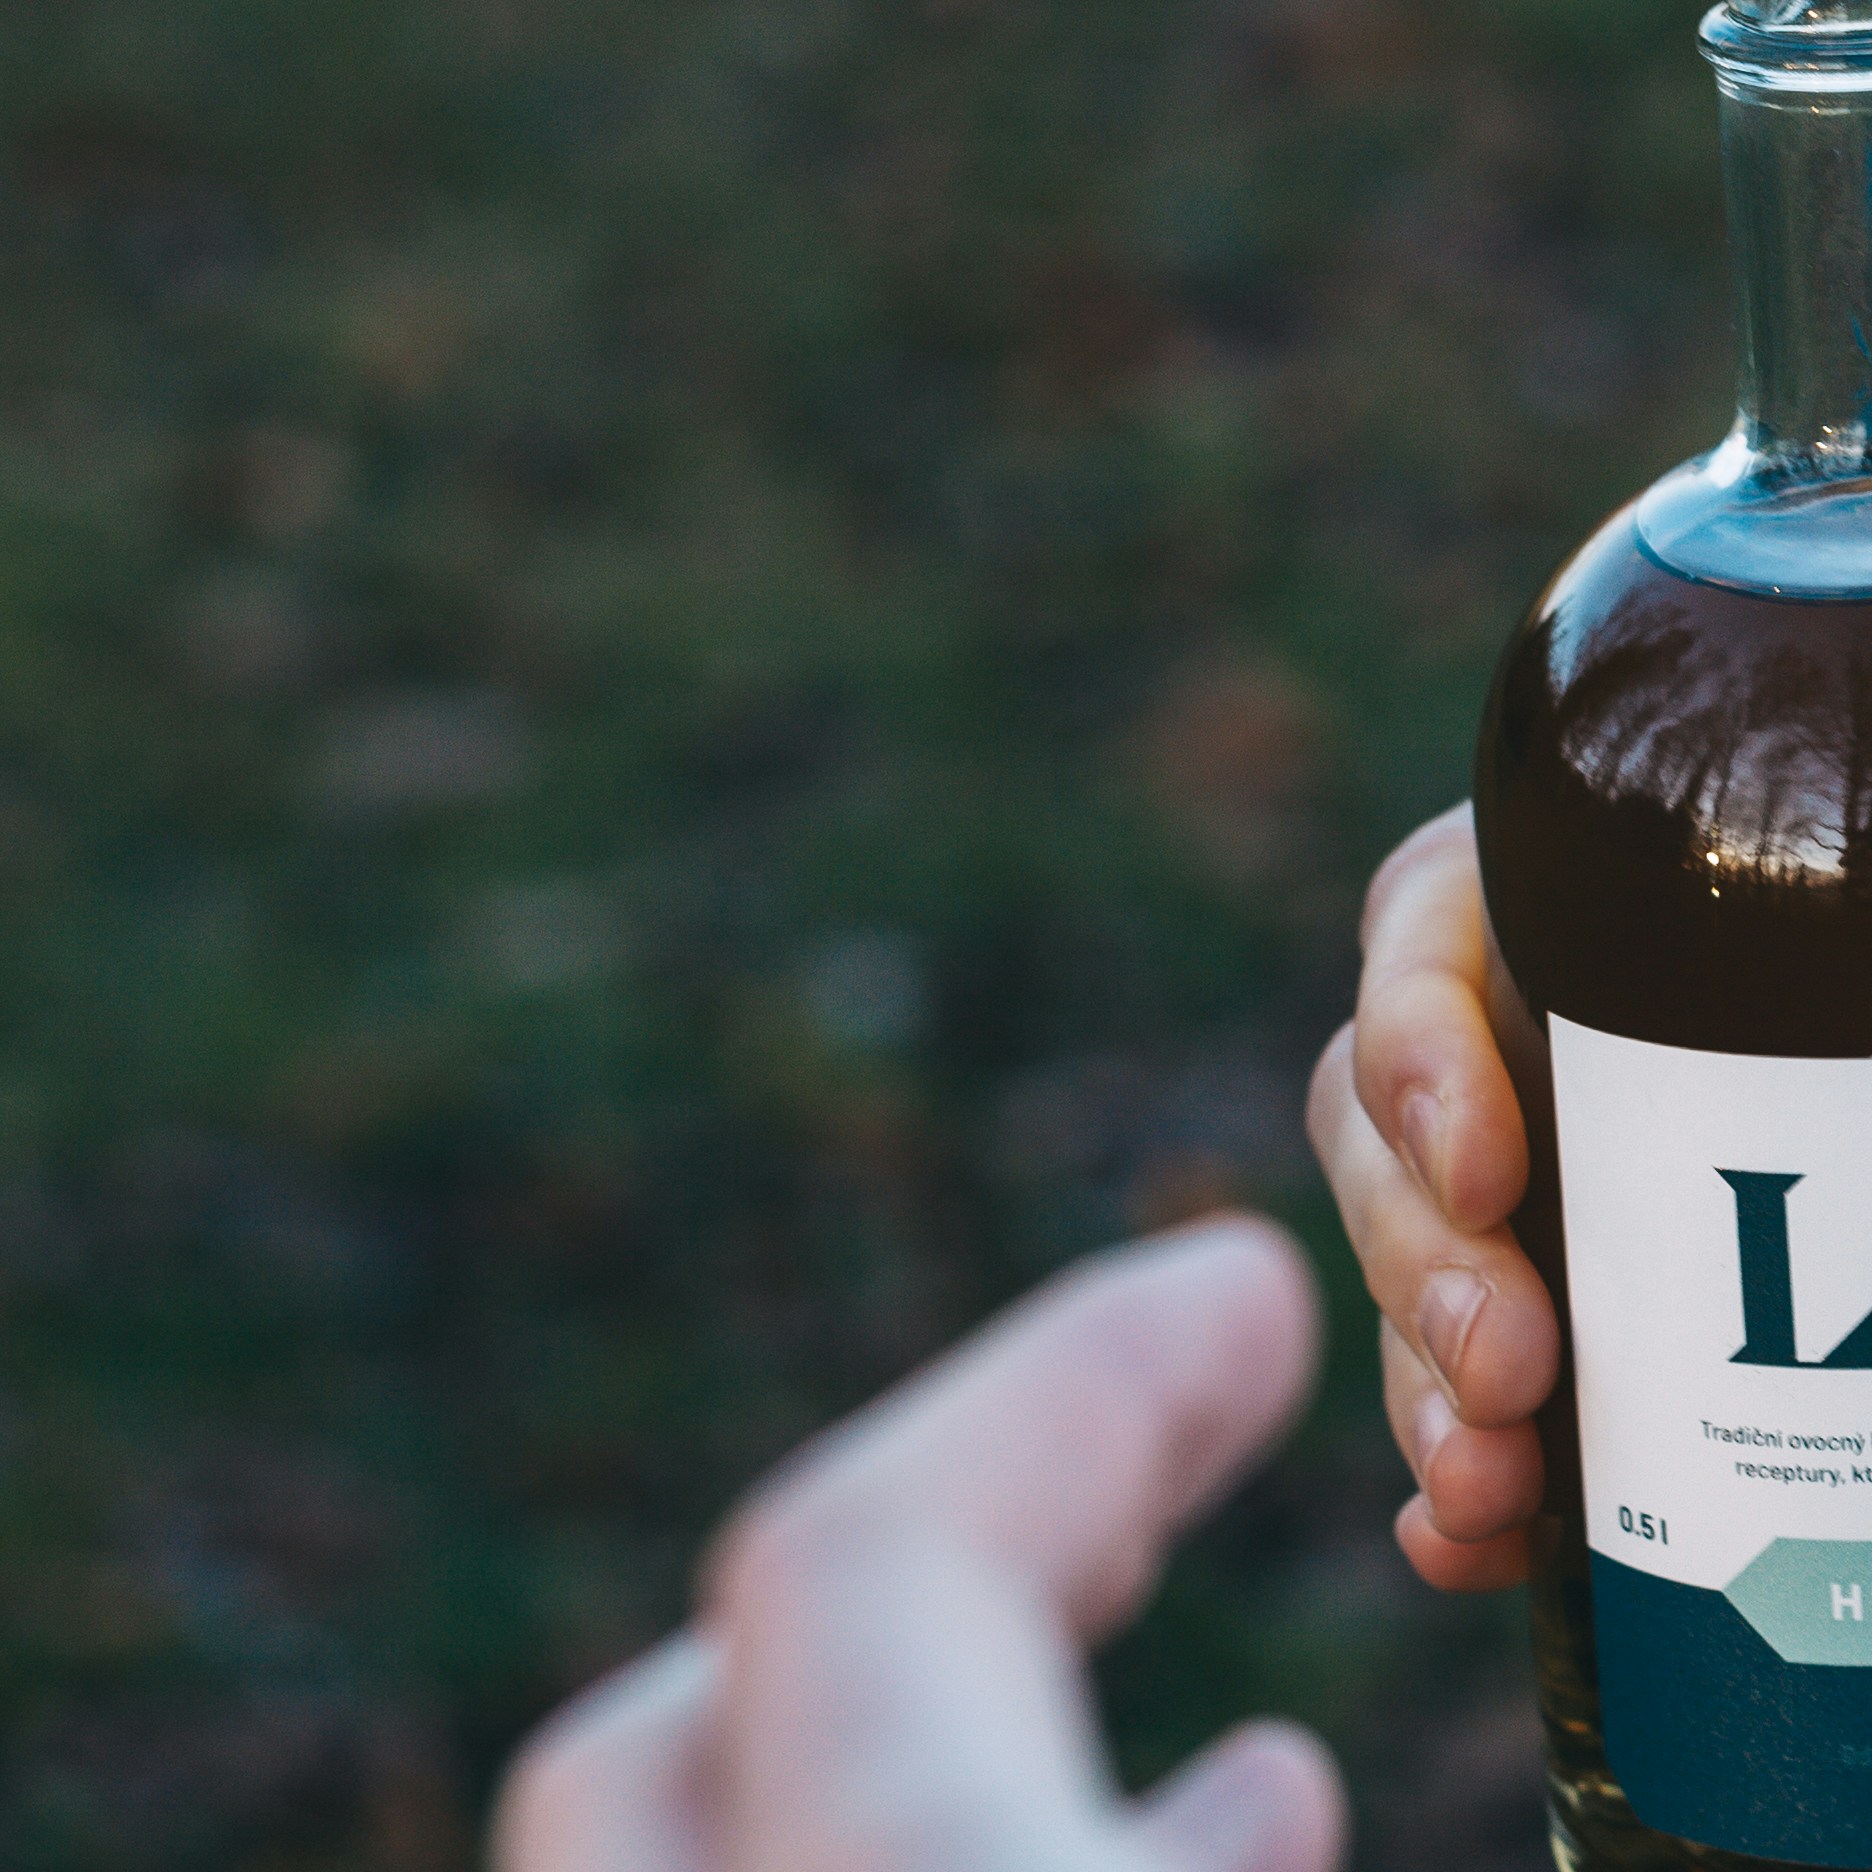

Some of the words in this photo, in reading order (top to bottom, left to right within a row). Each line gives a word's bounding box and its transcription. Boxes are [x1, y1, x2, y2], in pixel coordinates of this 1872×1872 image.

[1699, 1418, 1783, 1449] Tradiční
[1787, 1431, 1866, 1456] ovocný
[1734, 1459, 1846, 1488] receptury,
